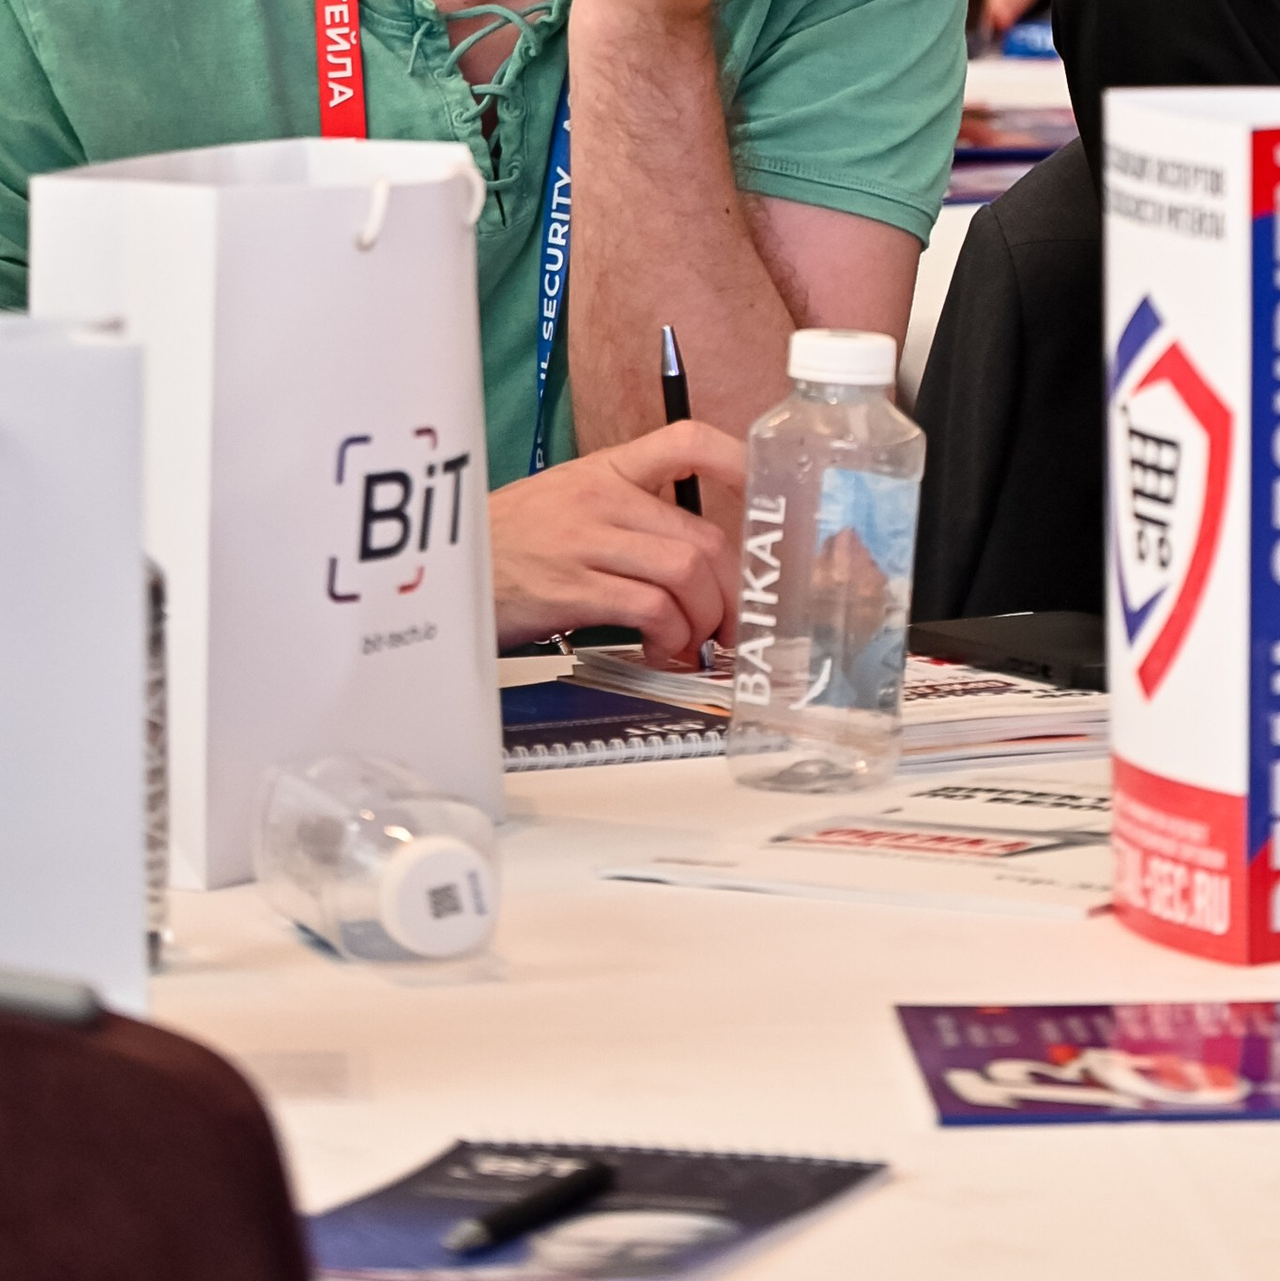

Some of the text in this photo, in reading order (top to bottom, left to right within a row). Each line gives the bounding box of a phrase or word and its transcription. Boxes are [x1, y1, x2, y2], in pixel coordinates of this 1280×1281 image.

[542, 166, 571, 342] SECURITY
[358, 451, 470, 564] BiT
[735, 493, 787, 707] BAIKAL
